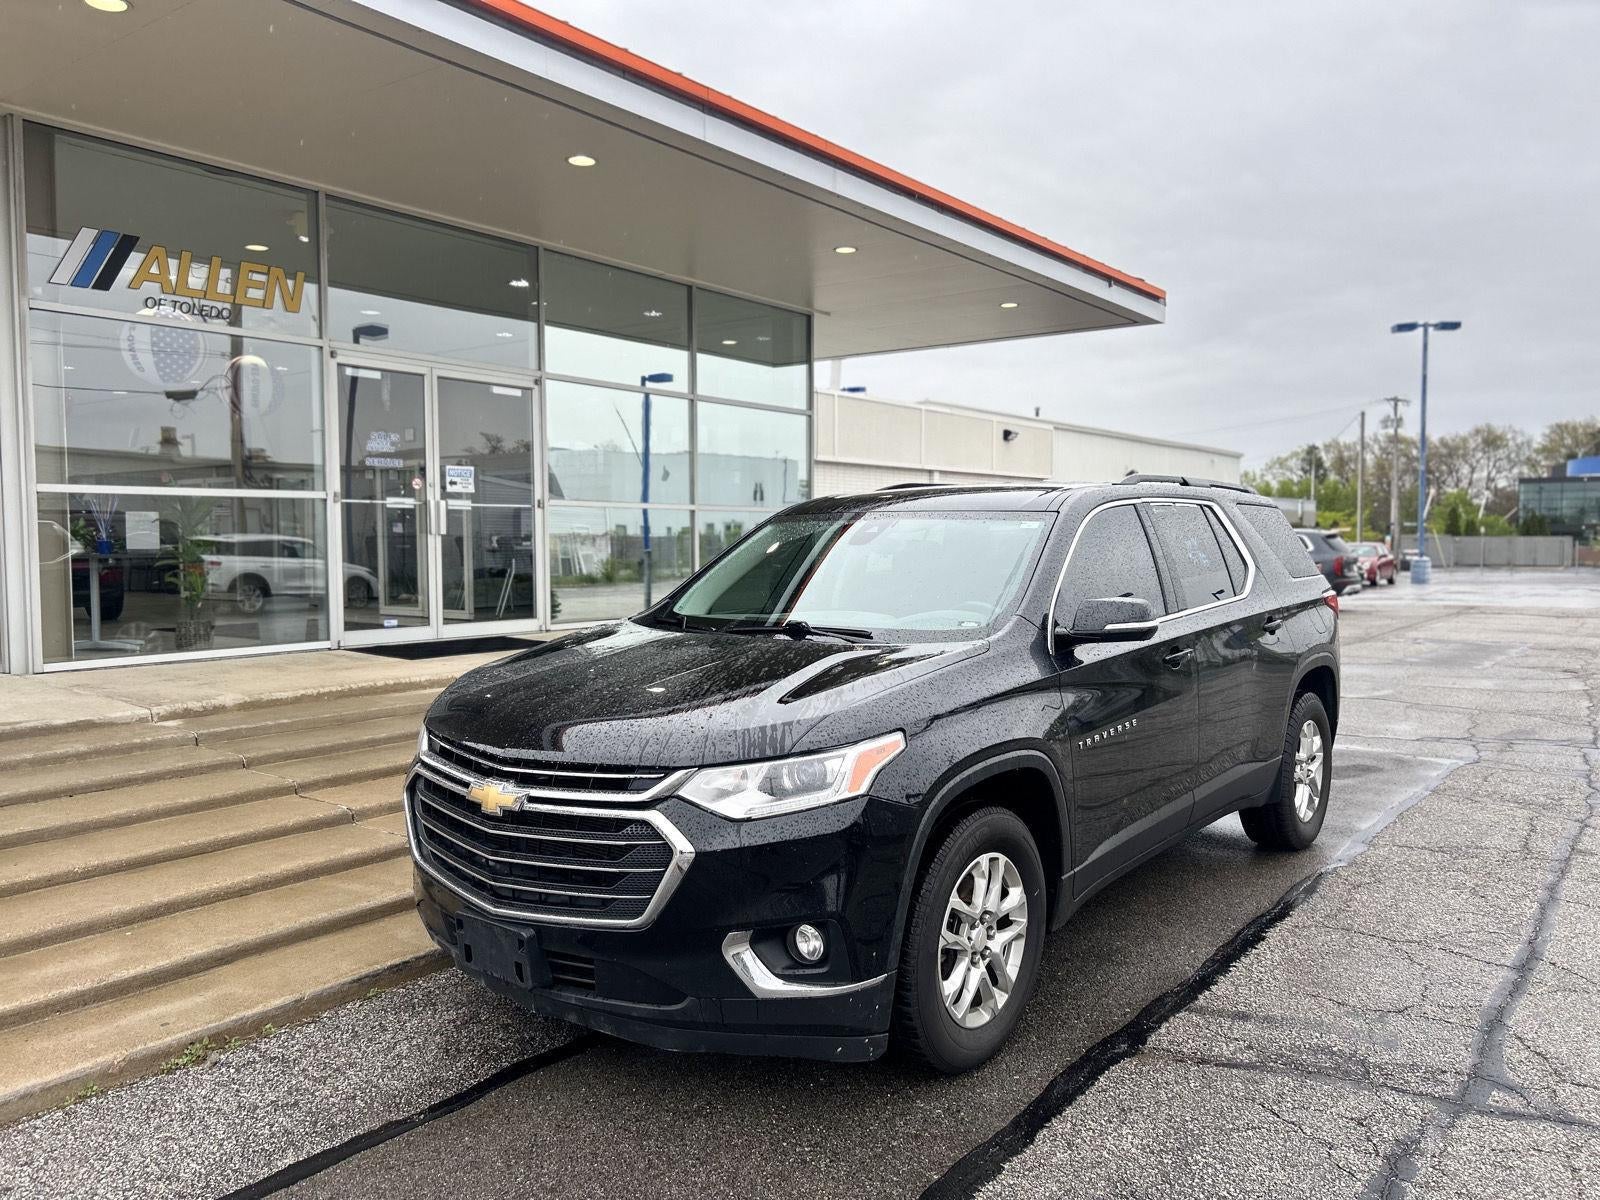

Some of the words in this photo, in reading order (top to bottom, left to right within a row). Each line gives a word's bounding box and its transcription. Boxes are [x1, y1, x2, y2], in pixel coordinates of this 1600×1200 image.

[128, 244, 305, 313] ALLEN
[145, 296, 168, 310] OF
[171, 299, 232, 320] TOLEDO
[448, 469, 471, 478] NOTICE
[1078, 718, 1137, 750] TRAVERSE
